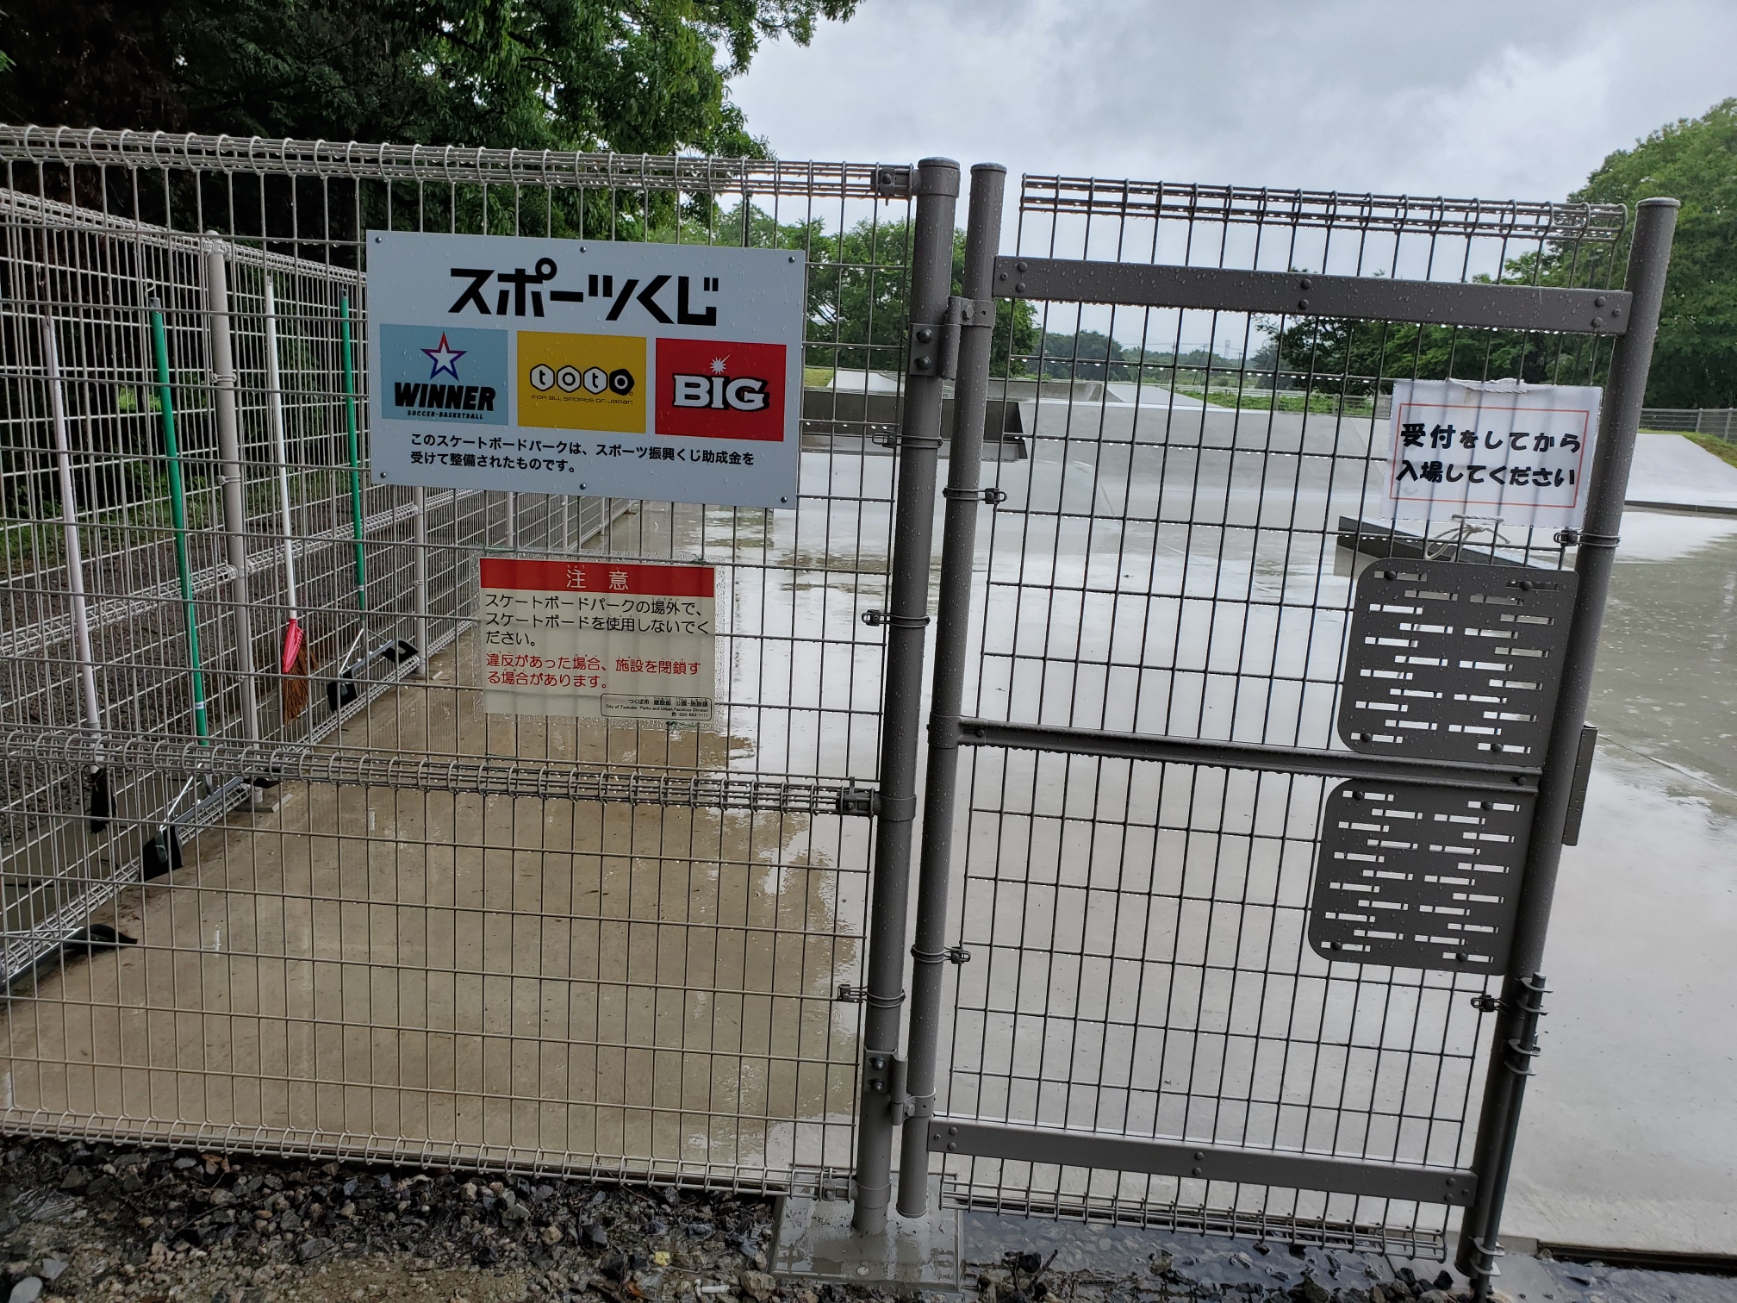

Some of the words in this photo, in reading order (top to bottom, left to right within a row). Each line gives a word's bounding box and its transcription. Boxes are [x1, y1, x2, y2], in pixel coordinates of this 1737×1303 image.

[448, 257, 719, 327] スポーツくじ
[394, 381, 497, 411] WINNER
[673, 374, 767, 411] BIG
[1400, 423, 1581, 453] 受付をしてから
[410, 451, 575, 473] 受けて整備されたものです。
[1395, 459, 1575, 487] 入場してください
[566, 568, 629, 591] 注意
[485, 593, 702, 616] スケートボードパークの場外で、
[485, 612, 709, 635] スケートボードを使用しないでく
[485, 630, 536, 647] ださい。
[487, 670, 608, 689] る場合があります。
